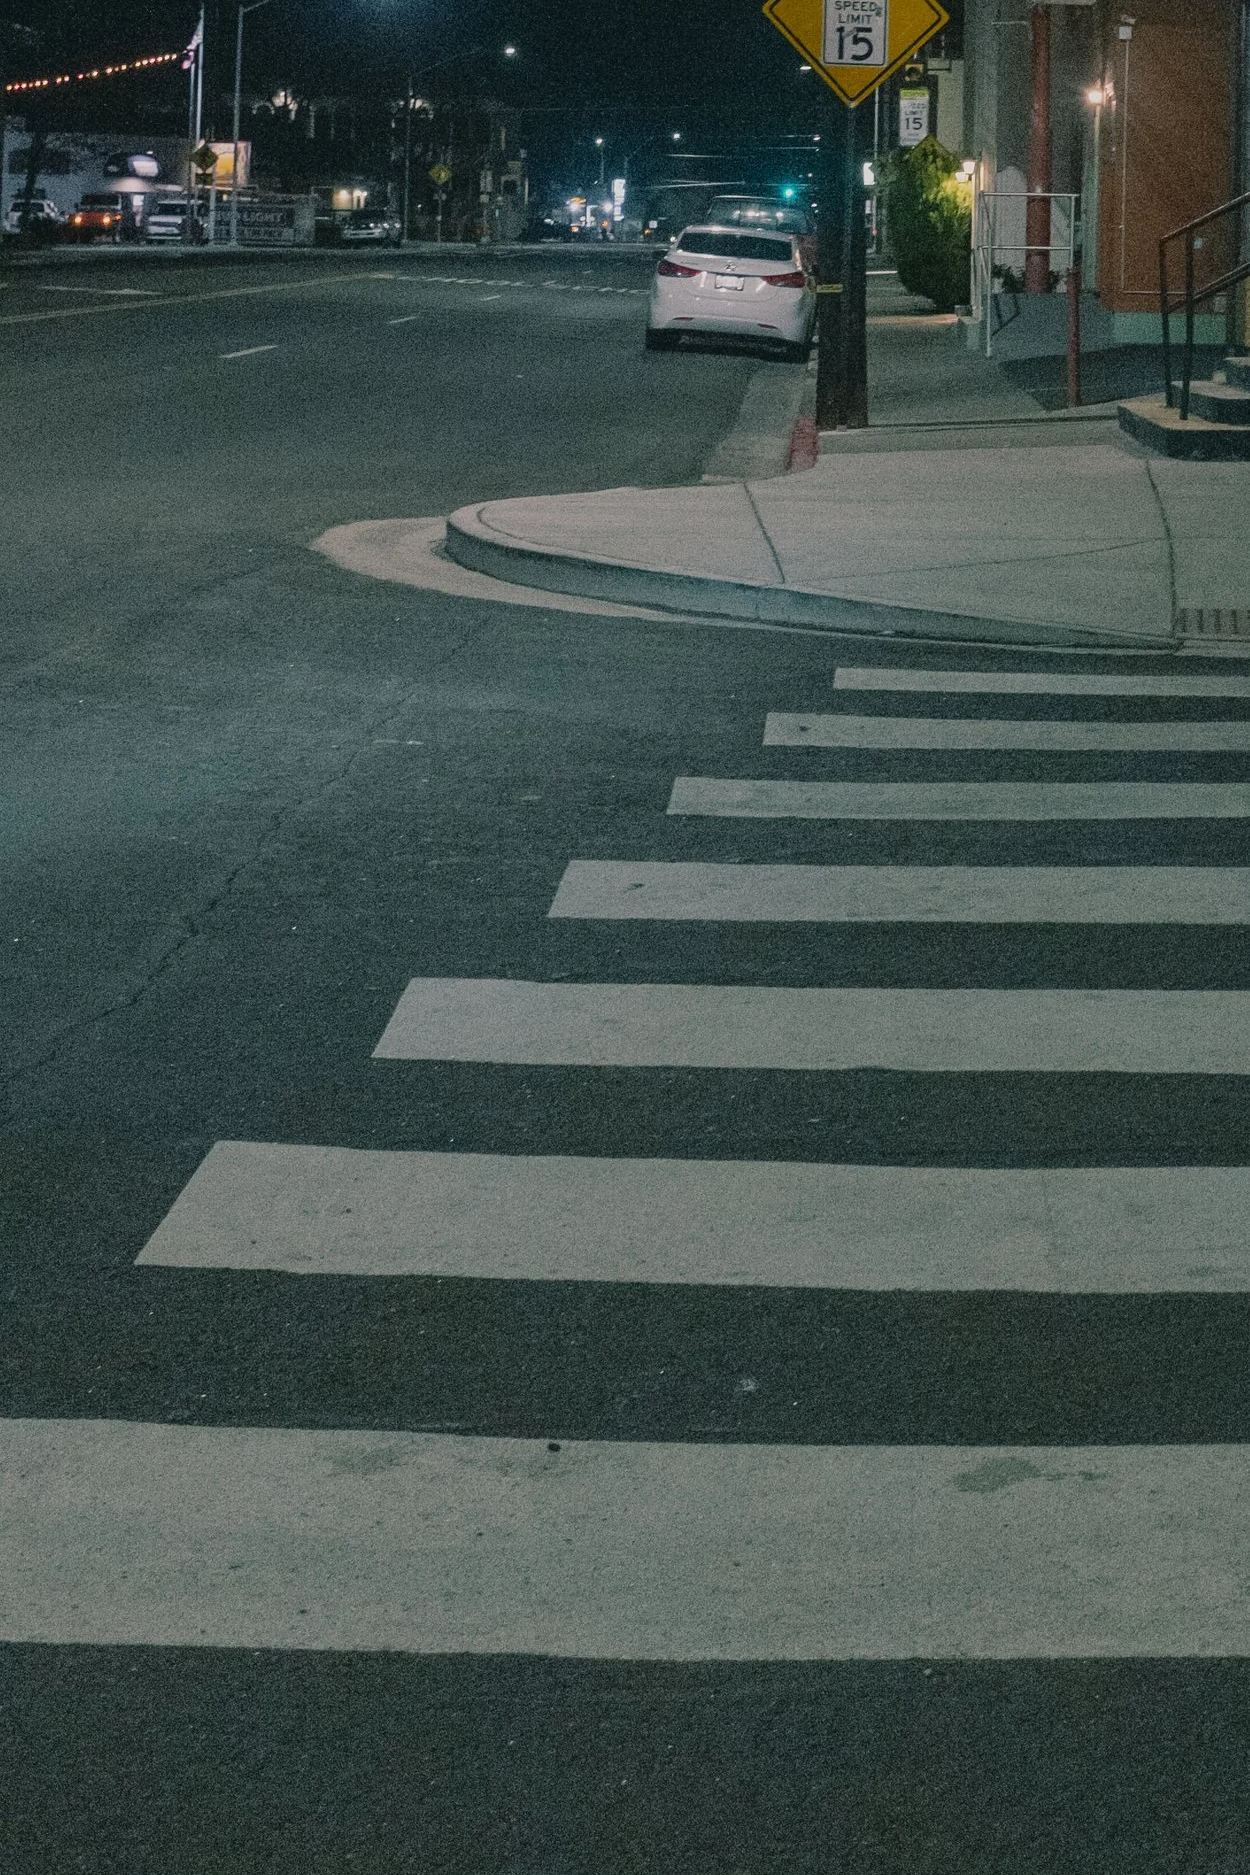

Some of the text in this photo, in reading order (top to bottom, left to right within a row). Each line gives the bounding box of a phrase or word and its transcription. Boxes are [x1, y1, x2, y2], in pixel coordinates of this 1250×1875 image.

[835, 0, 878, 12] SPEED
[838, 14, 873, 25] LIMIT
[836, 26, 874, 61] 15
[905, 117, 923, 131] 15
